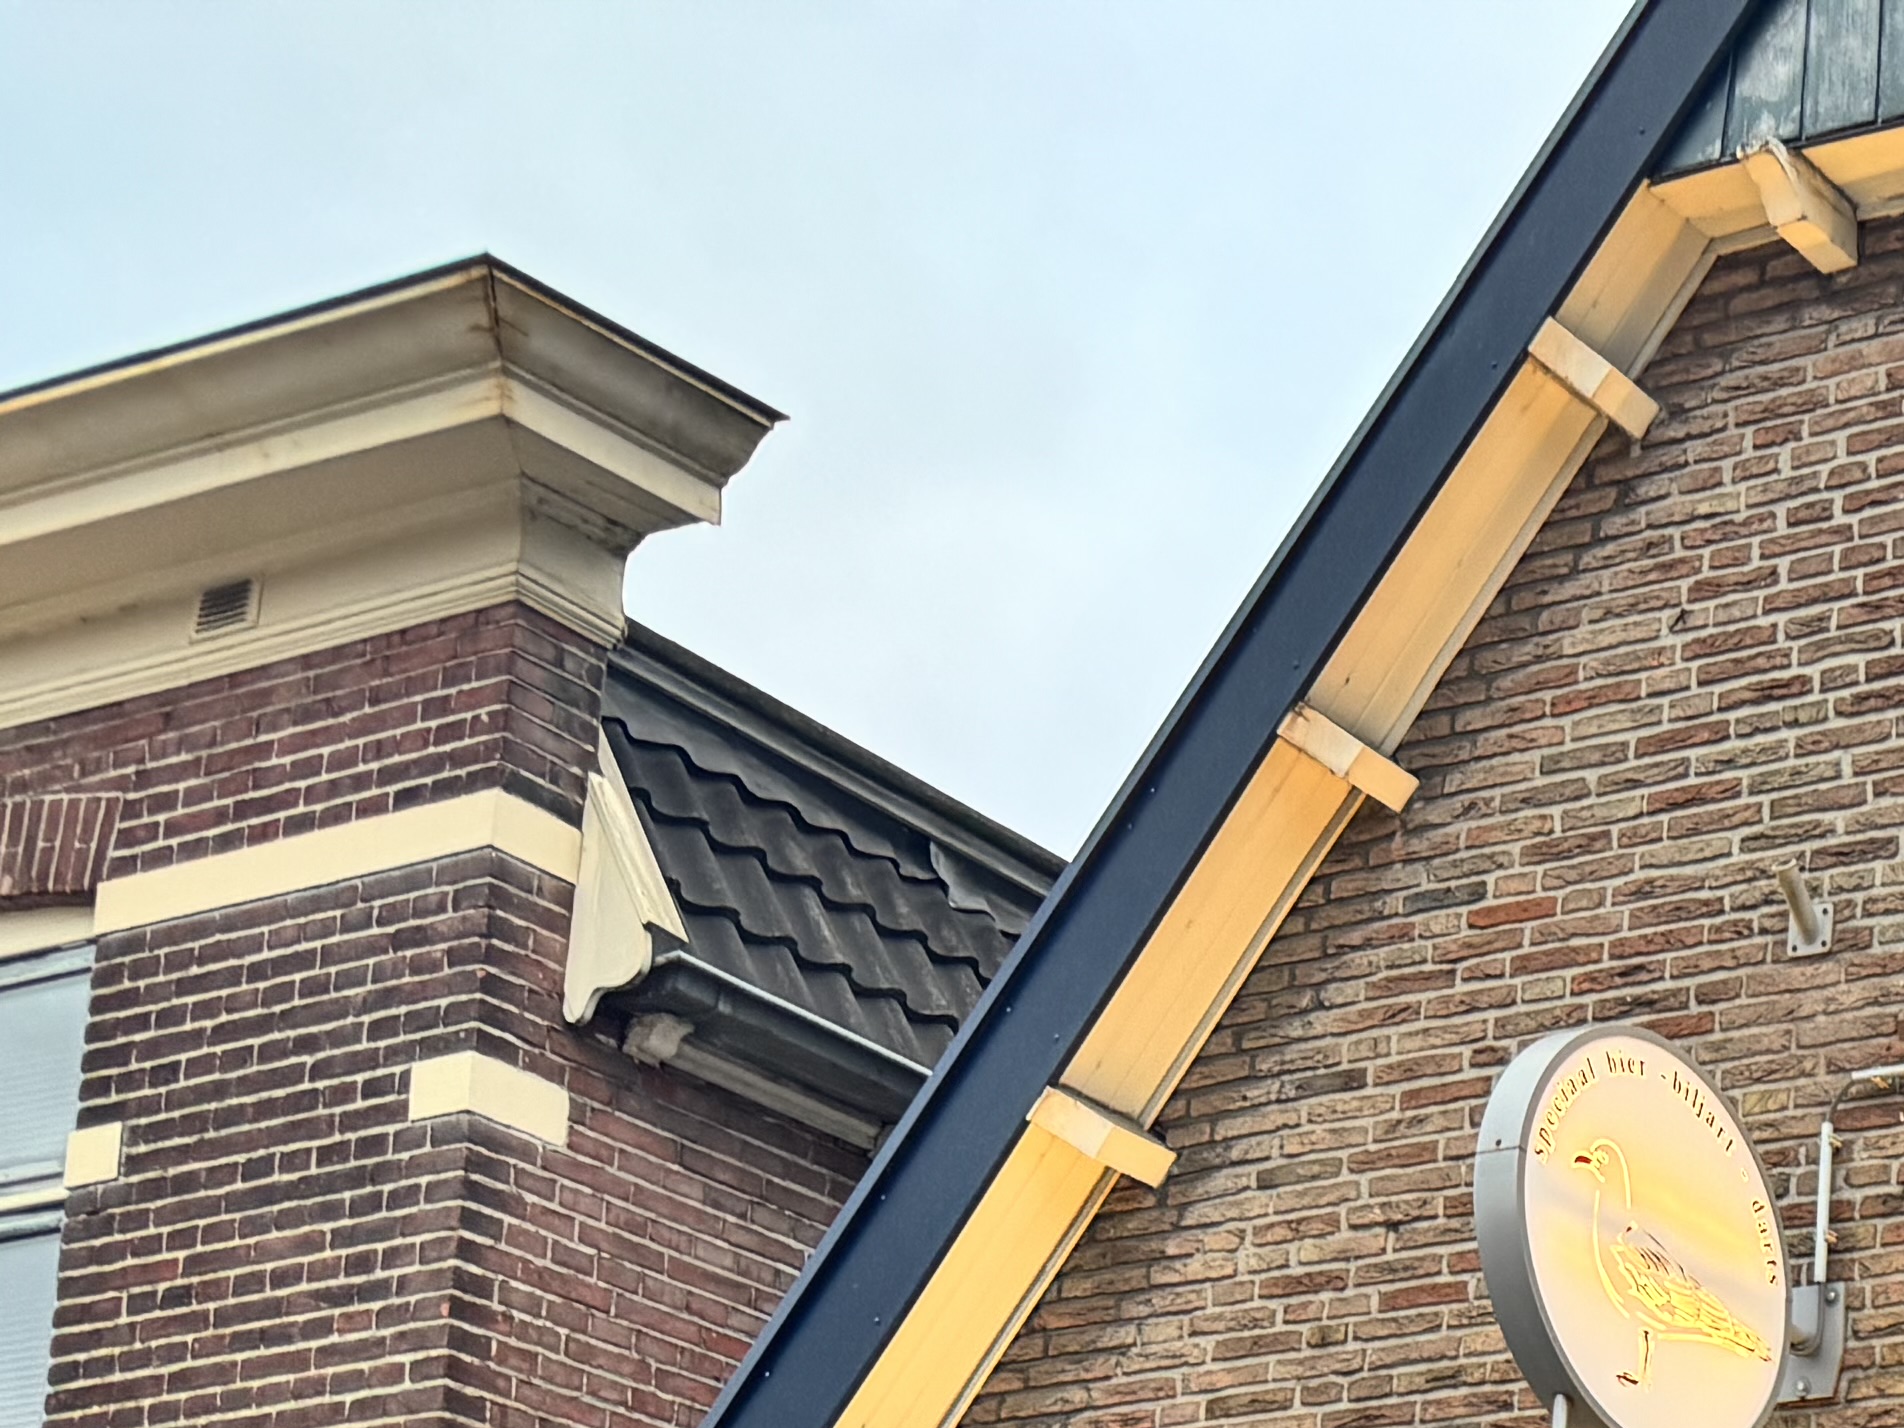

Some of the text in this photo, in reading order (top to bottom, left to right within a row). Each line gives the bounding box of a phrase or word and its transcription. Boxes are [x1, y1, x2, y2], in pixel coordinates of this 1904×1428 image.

[1534, 1056, 1597, 1160] speciaal
[1605, 1050, 1646, 1077] bier
[1751, 1199, 1779, 1287] darts
